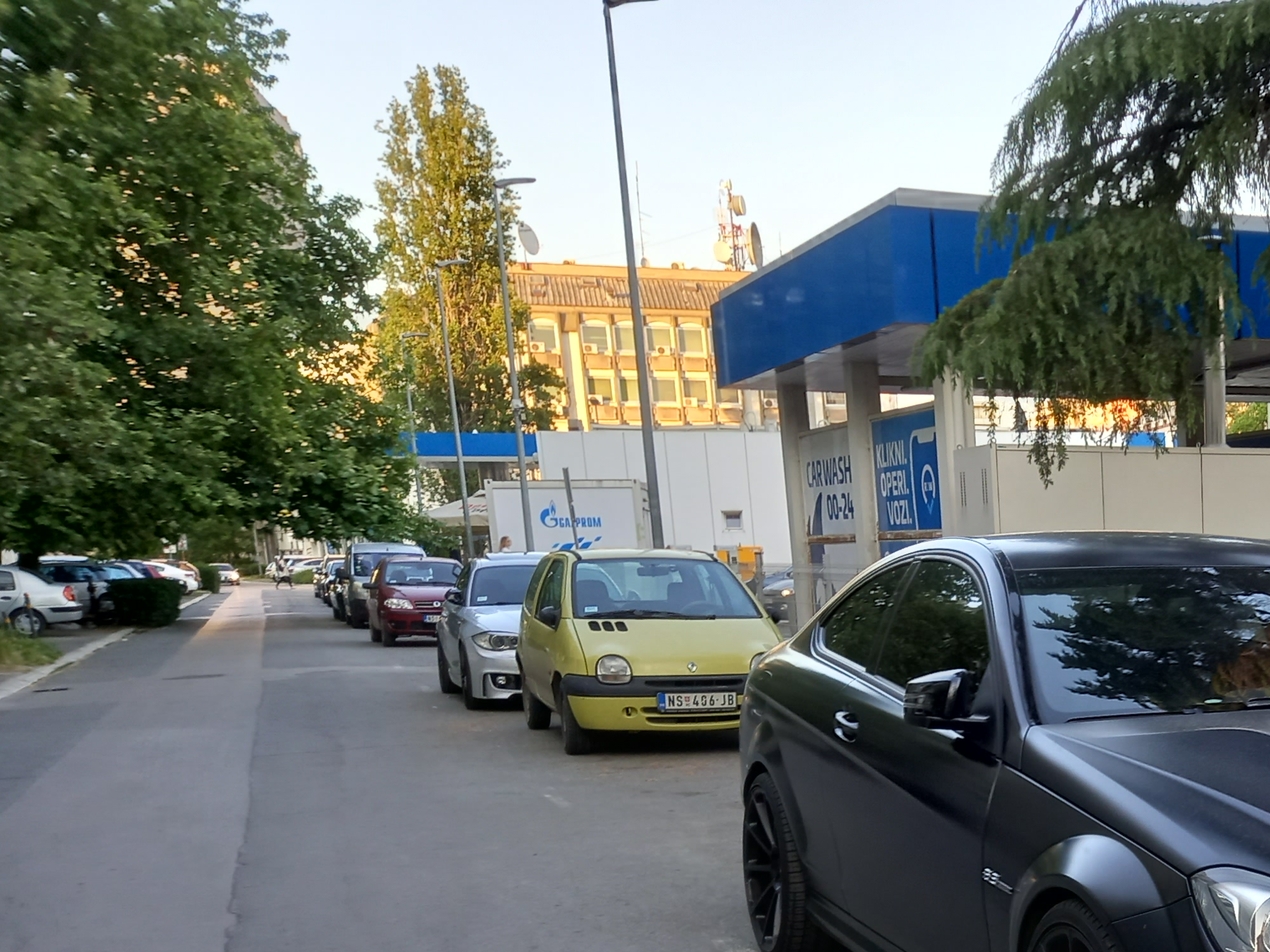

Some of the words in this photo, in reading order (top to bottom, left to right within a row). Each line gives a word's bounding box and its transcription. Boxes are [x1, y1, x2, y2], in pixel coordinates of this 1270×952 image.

[875, 440, 907, 468] KLIKNI.
[880, 470, 910, 498] OPERI.
[827, 492, 854, 521] 00-24
[887, 499, 913, 526] VOZI.
[668, 695, 683, 707] NS
